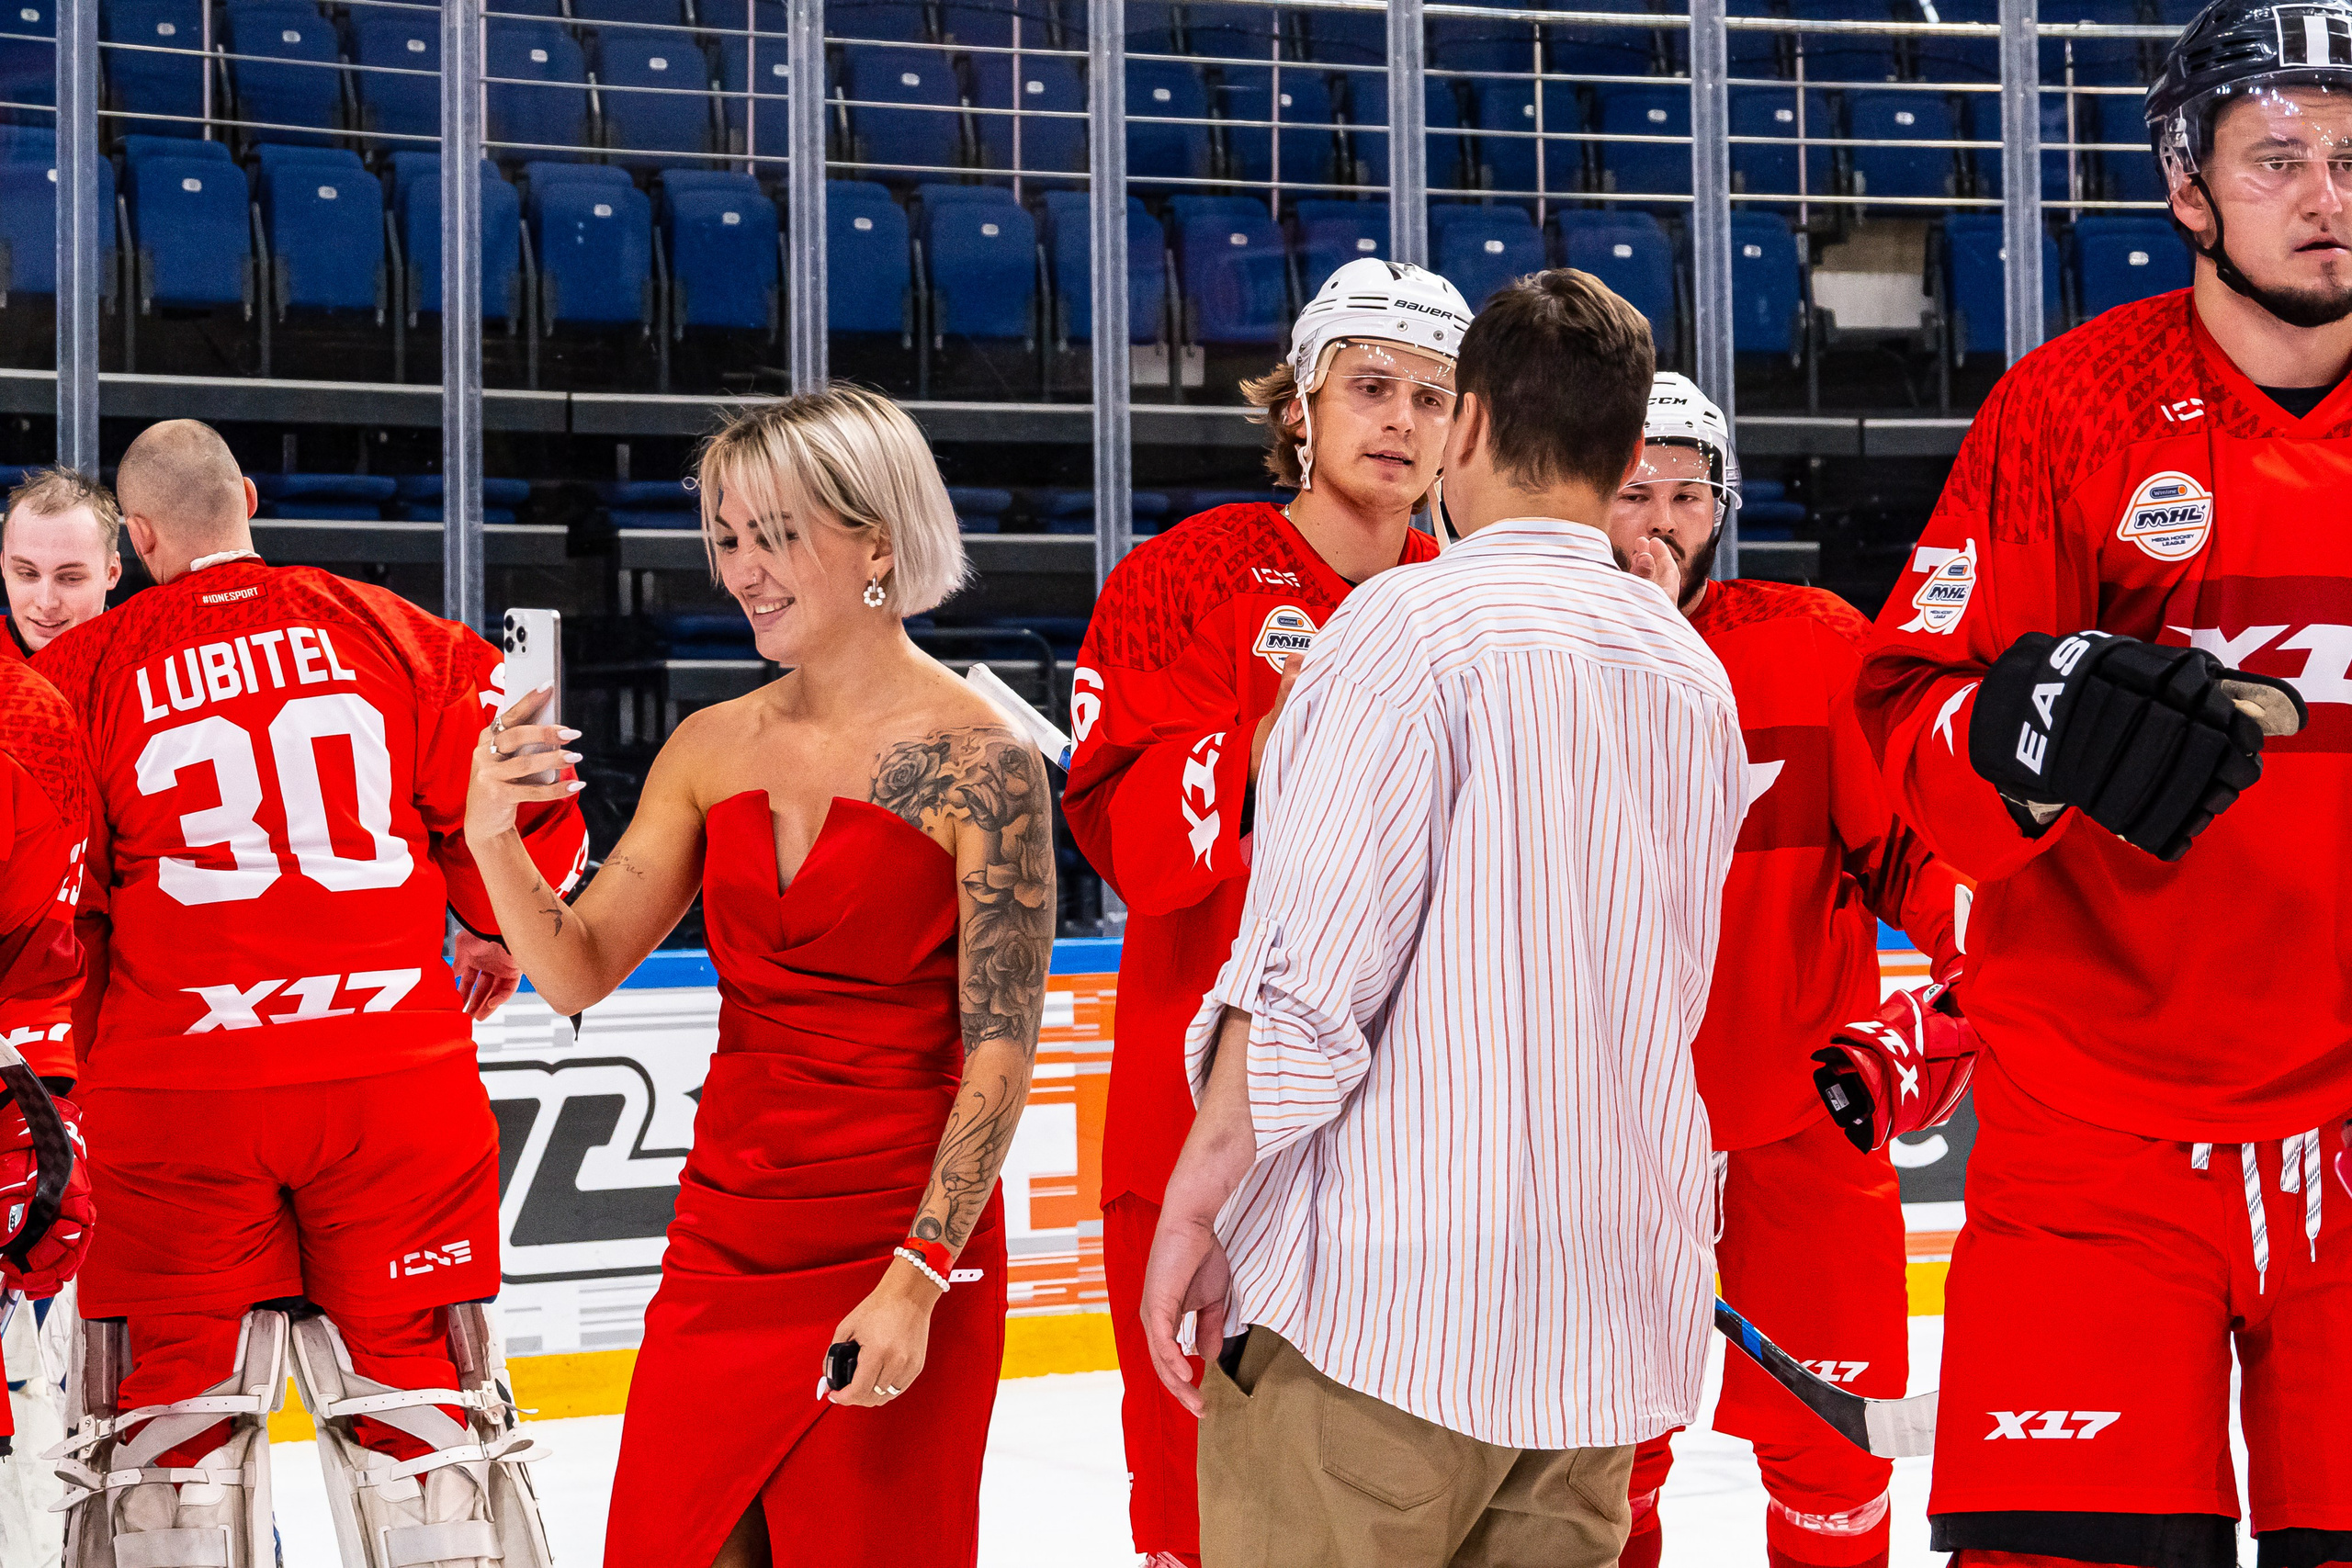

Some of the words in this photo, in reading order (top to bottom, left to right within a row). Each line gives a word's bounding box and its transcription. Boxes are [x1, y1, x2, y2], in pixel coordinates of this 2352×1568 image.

[2135, 505, 2203, 528] MHL
[202, 587, 258, 604] #IONESPORT
[1928, 585, 1966, 600] MHL
[137, 626, 356, 723] LUBITEL
[135, 694, 414, 906] 30
[180, 968, 422, 1034] X17
[1984, 1410, 2122, 1440] X17
